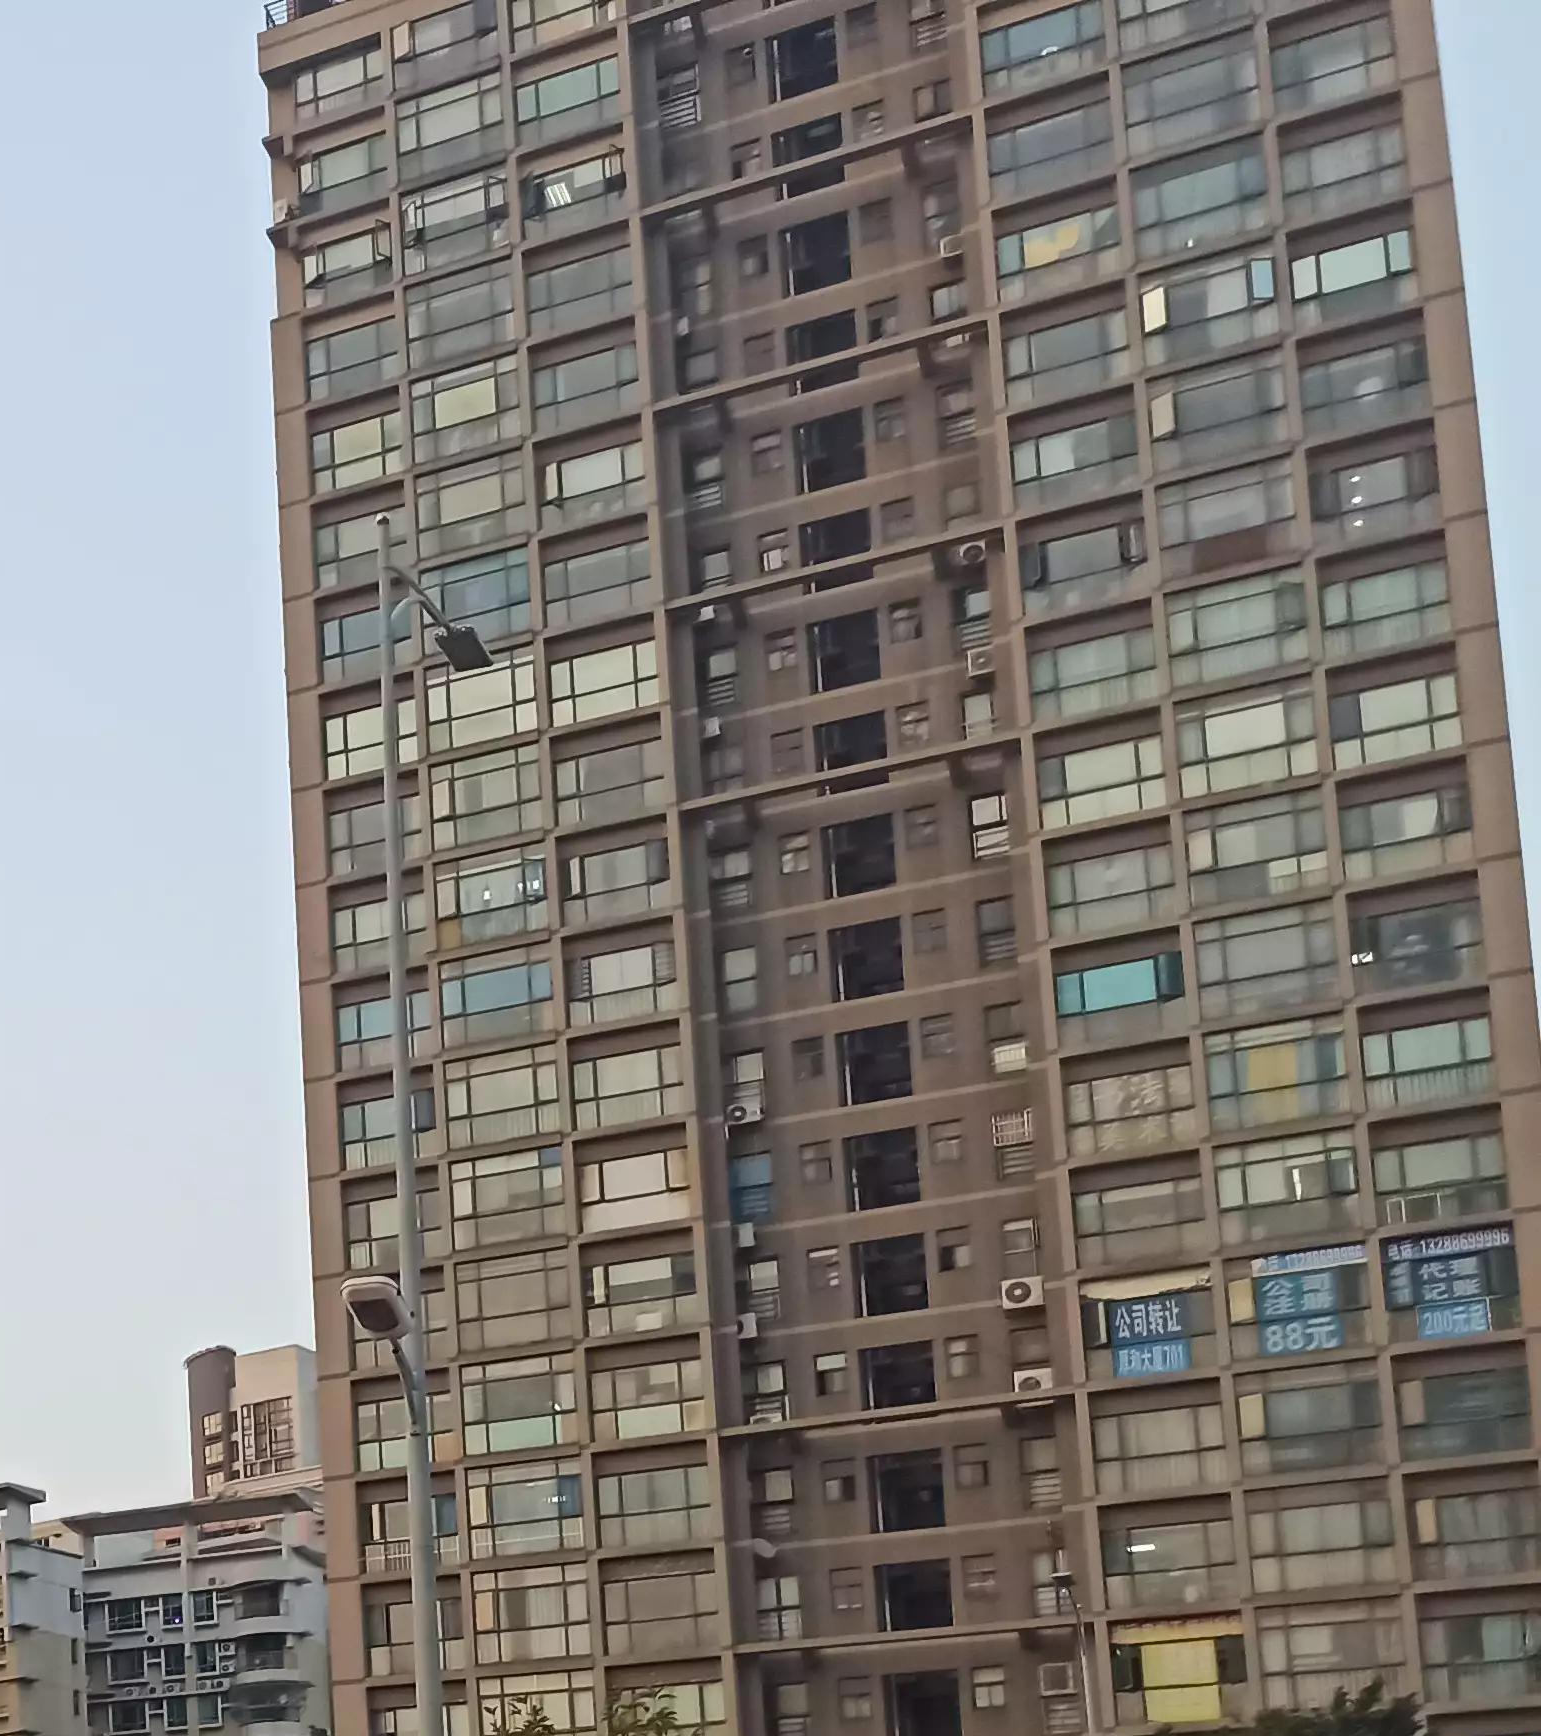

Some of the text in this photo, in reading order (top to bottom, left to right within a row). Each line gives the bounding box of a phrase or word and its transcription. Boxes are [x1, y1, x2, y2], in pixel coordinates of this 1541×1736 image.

[1114, 1298, 1182, 1338] 公司转让
[1265, 1316, 1338, 1353] 88元
